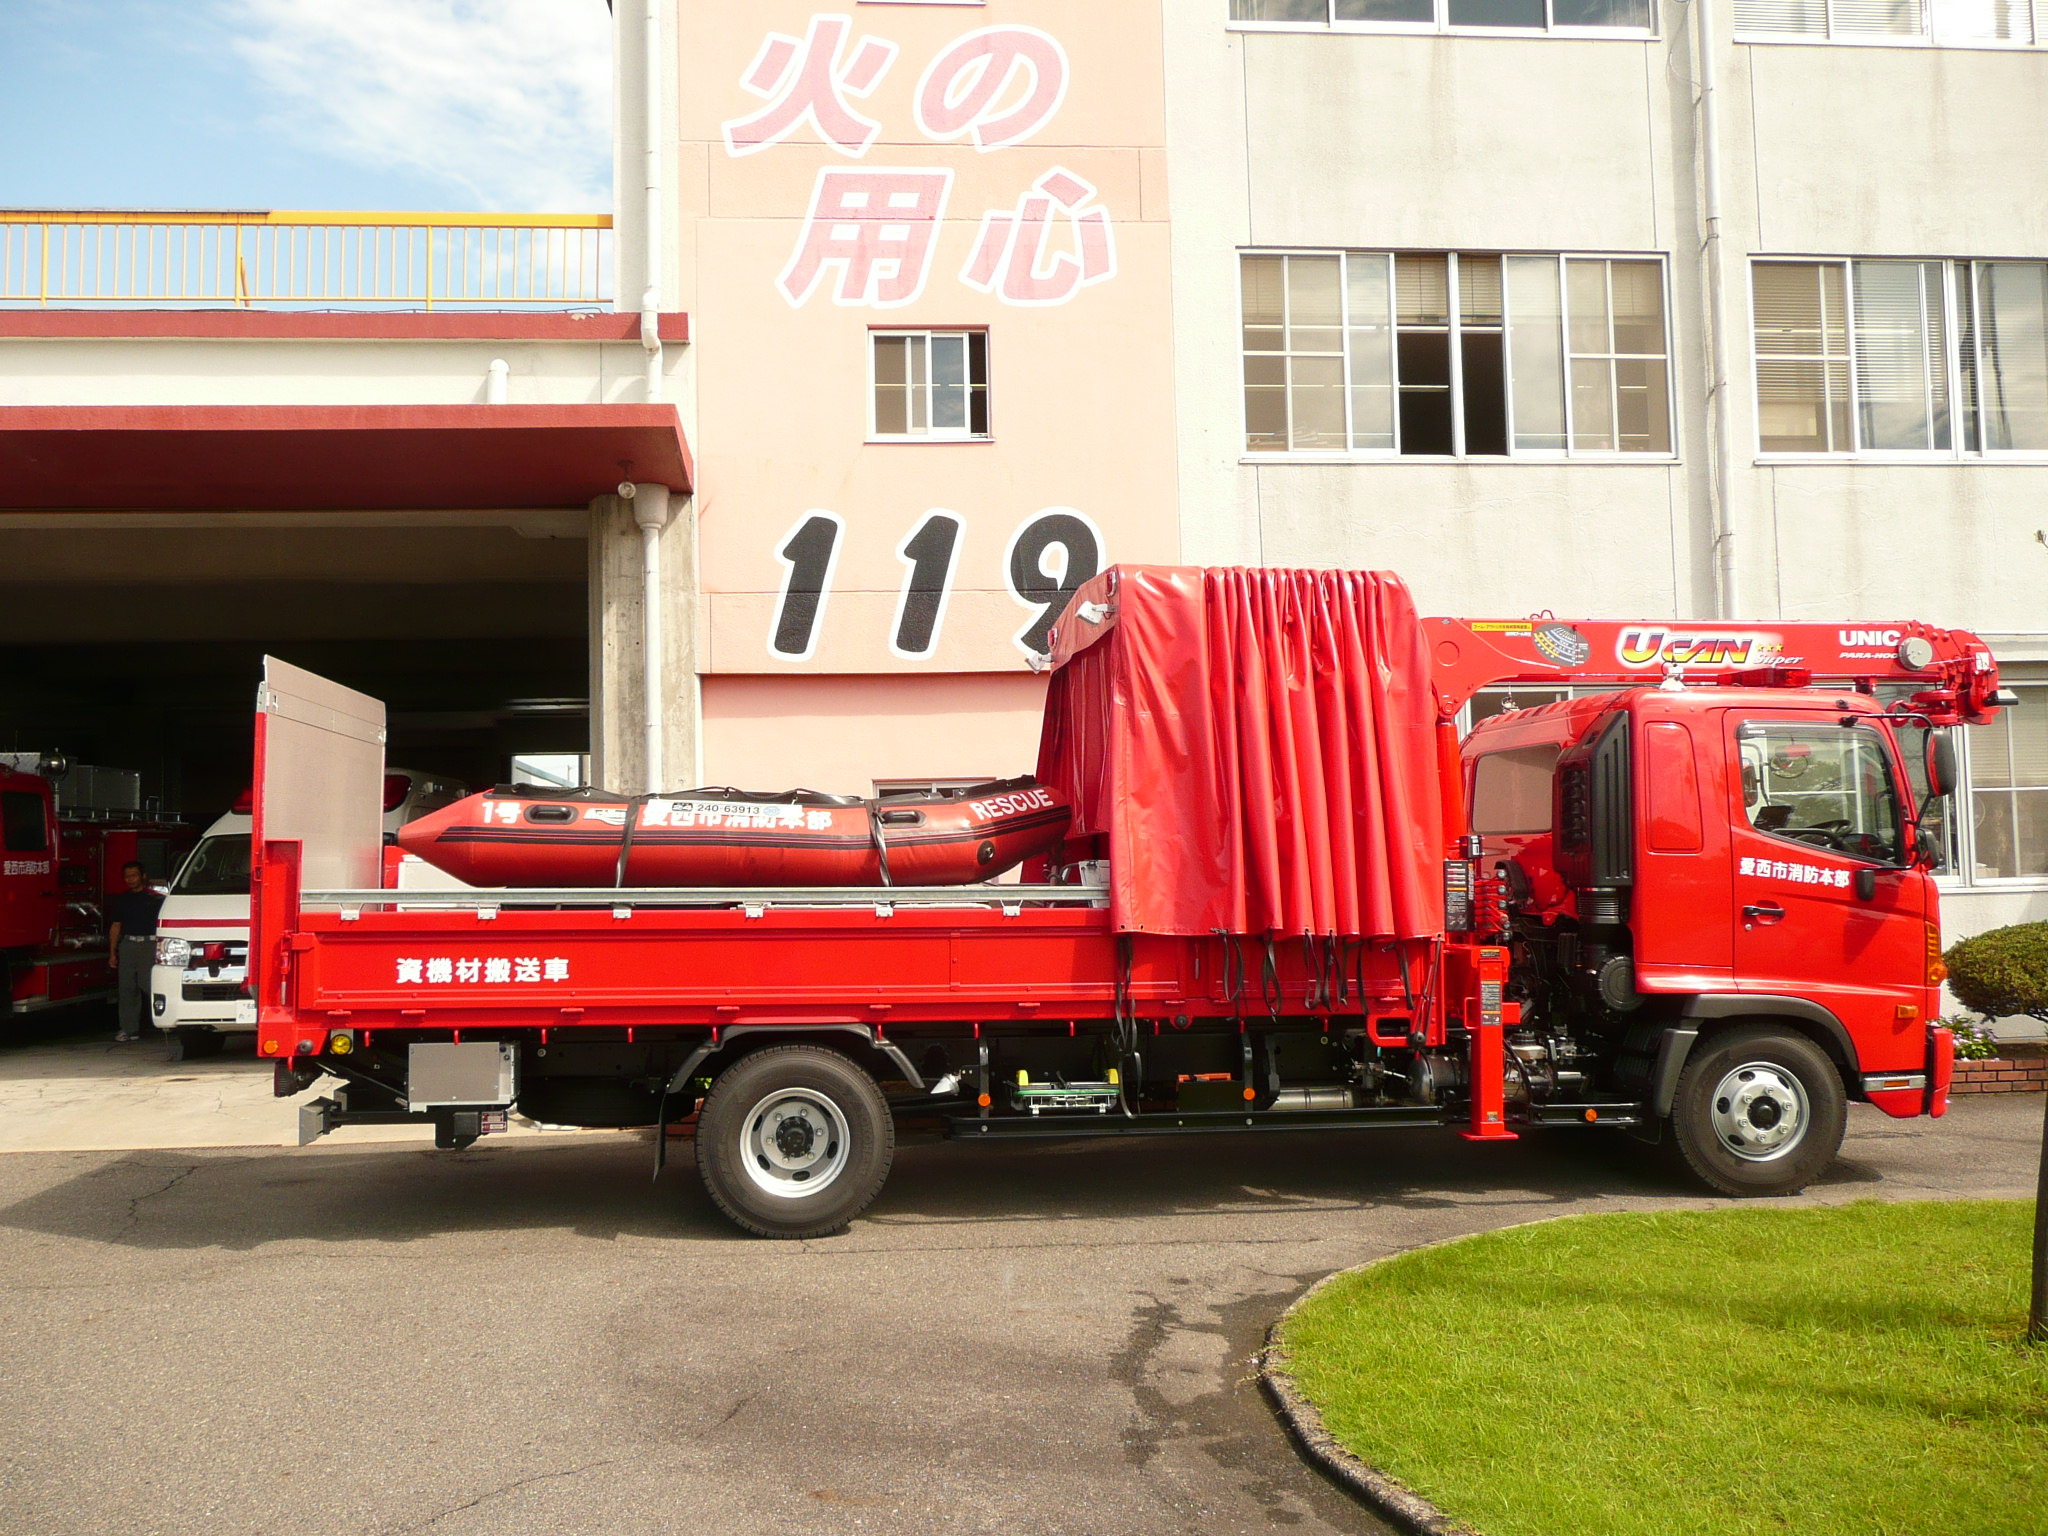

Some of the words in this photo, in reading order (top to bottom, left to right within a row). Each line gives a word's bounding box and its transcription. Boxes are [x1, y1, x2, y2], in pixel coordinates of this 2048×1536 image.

[721, 13, 1070, 158] 火の
[774, 166, 1118, 309] 用心
[766, 506, 1106, 662] 119
[1838, 629, 1901, 647] UNIC
[1753, 651, 1804, 666] Super
[1838, 652, 1899, 660] PARA-HOO
[481, 800, 522, 824] 1号
[968, 788, 1055, 821] RESCUE
[1739, 856, 1850, 888] 愛西市消防本部
[395, 956, 570, 984] 資機材搬送車
